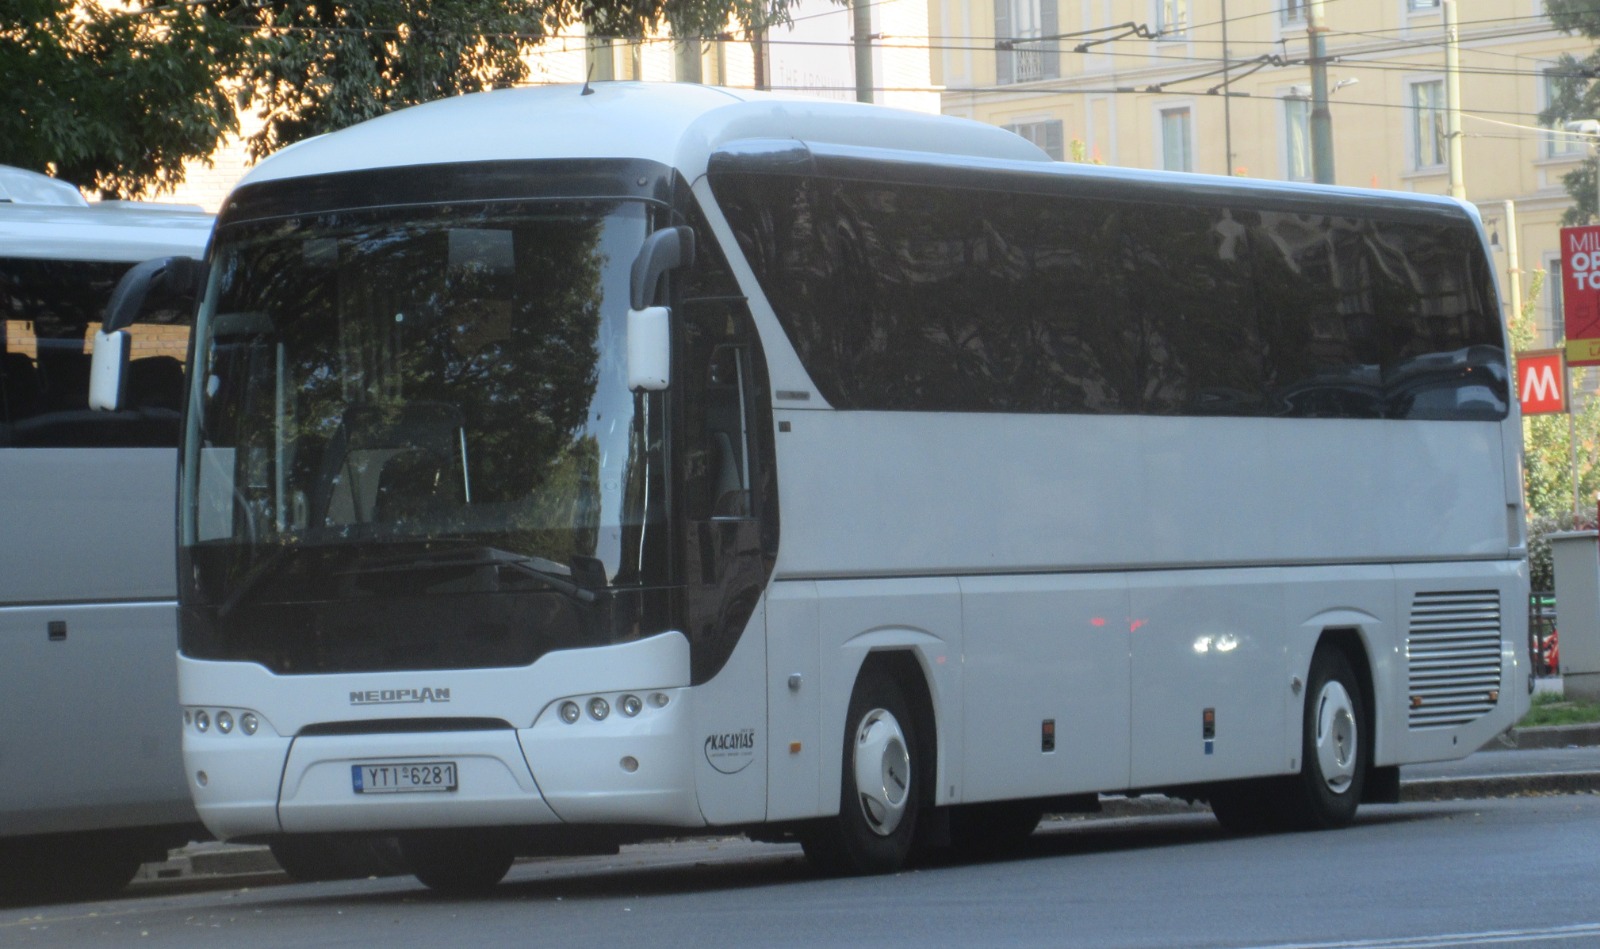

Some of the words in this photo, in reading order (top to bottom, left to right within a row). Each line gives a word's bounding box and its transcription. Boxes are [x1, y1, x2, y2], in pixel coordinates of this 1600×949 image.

[1570, 232, 1600, 252] MIL
[1523, 366, 1560, 402] M
[350, 687, 450, 705] NEOPLAN
